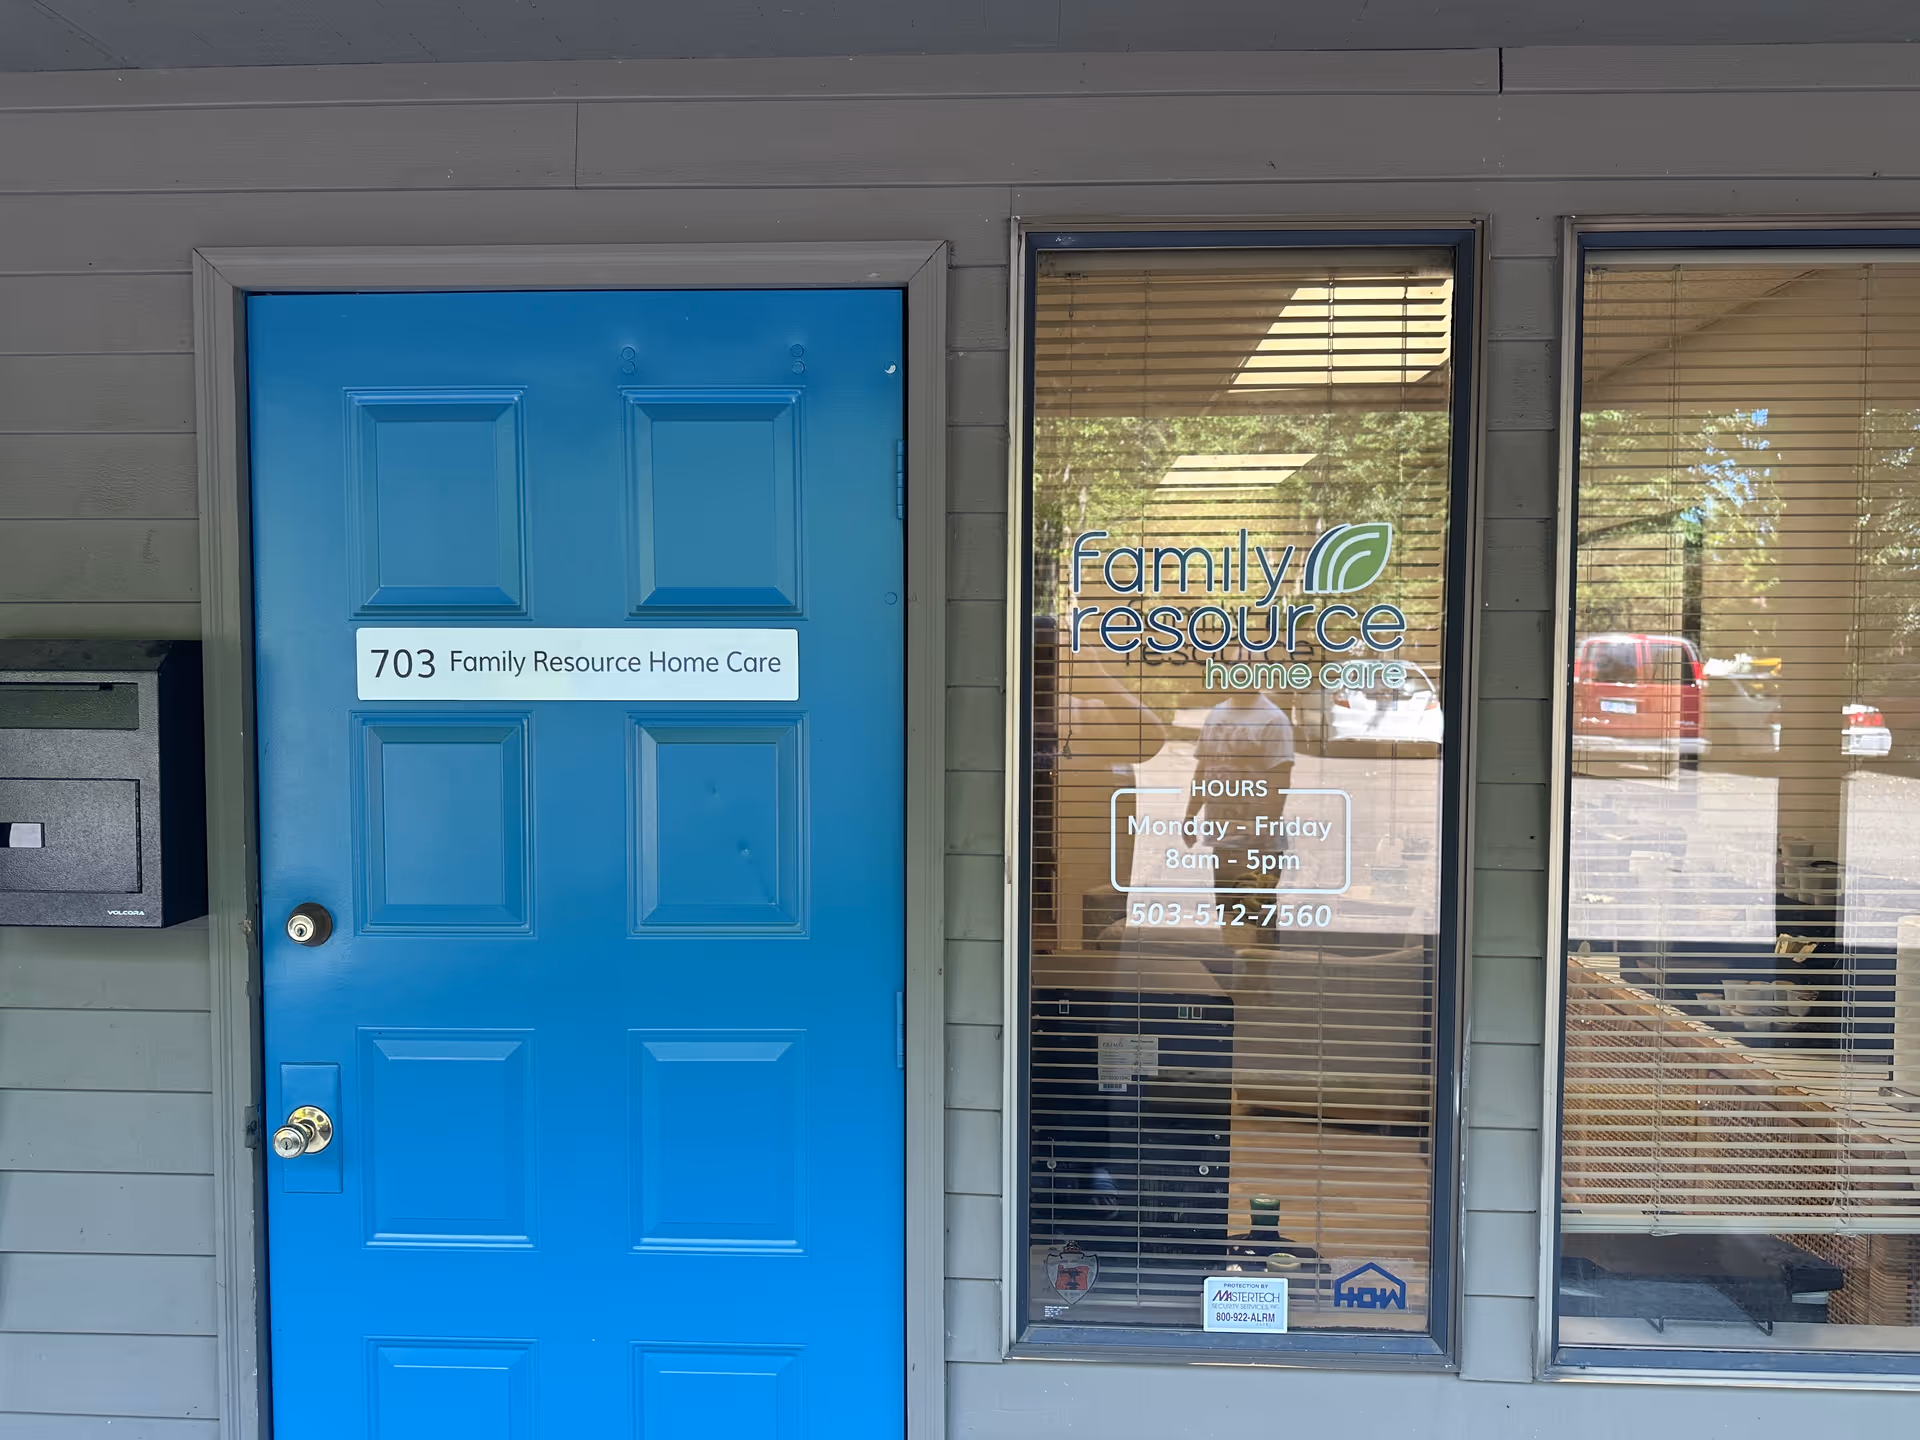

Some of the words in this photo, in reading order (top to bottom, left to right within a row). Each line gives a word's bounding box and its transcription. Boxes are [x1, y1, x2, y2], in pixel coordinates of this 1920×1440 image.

[1072, 528, 1295, 608] family
[1071, 603, 1407, 654] resource
[370, 648, 436, 679] 703
[449, 651, 526, 677] Family
[533, 651, 642, 673] Resource
[649, 651, 720, 673] Home
[726, 651, 782, 673] Care
[1205, 658, 1311, 689] home
[1318, 661, 1407, 690] care
[1191, 779, 1268, 798] HOURS
[1127, 815, 1230, 841] Monday
[1255, 815, 1333, 842] Friday
[1165, 848, 1219, 870] 8am
[1246, 849, 1300, 875] 5pm
[1130, 902, 1332, 928] 503-512-7560
[1212, 1289, 1281, 1303] MASTERTECH
[1216, 1311, 1276, 1323] 800-922-ALRM
